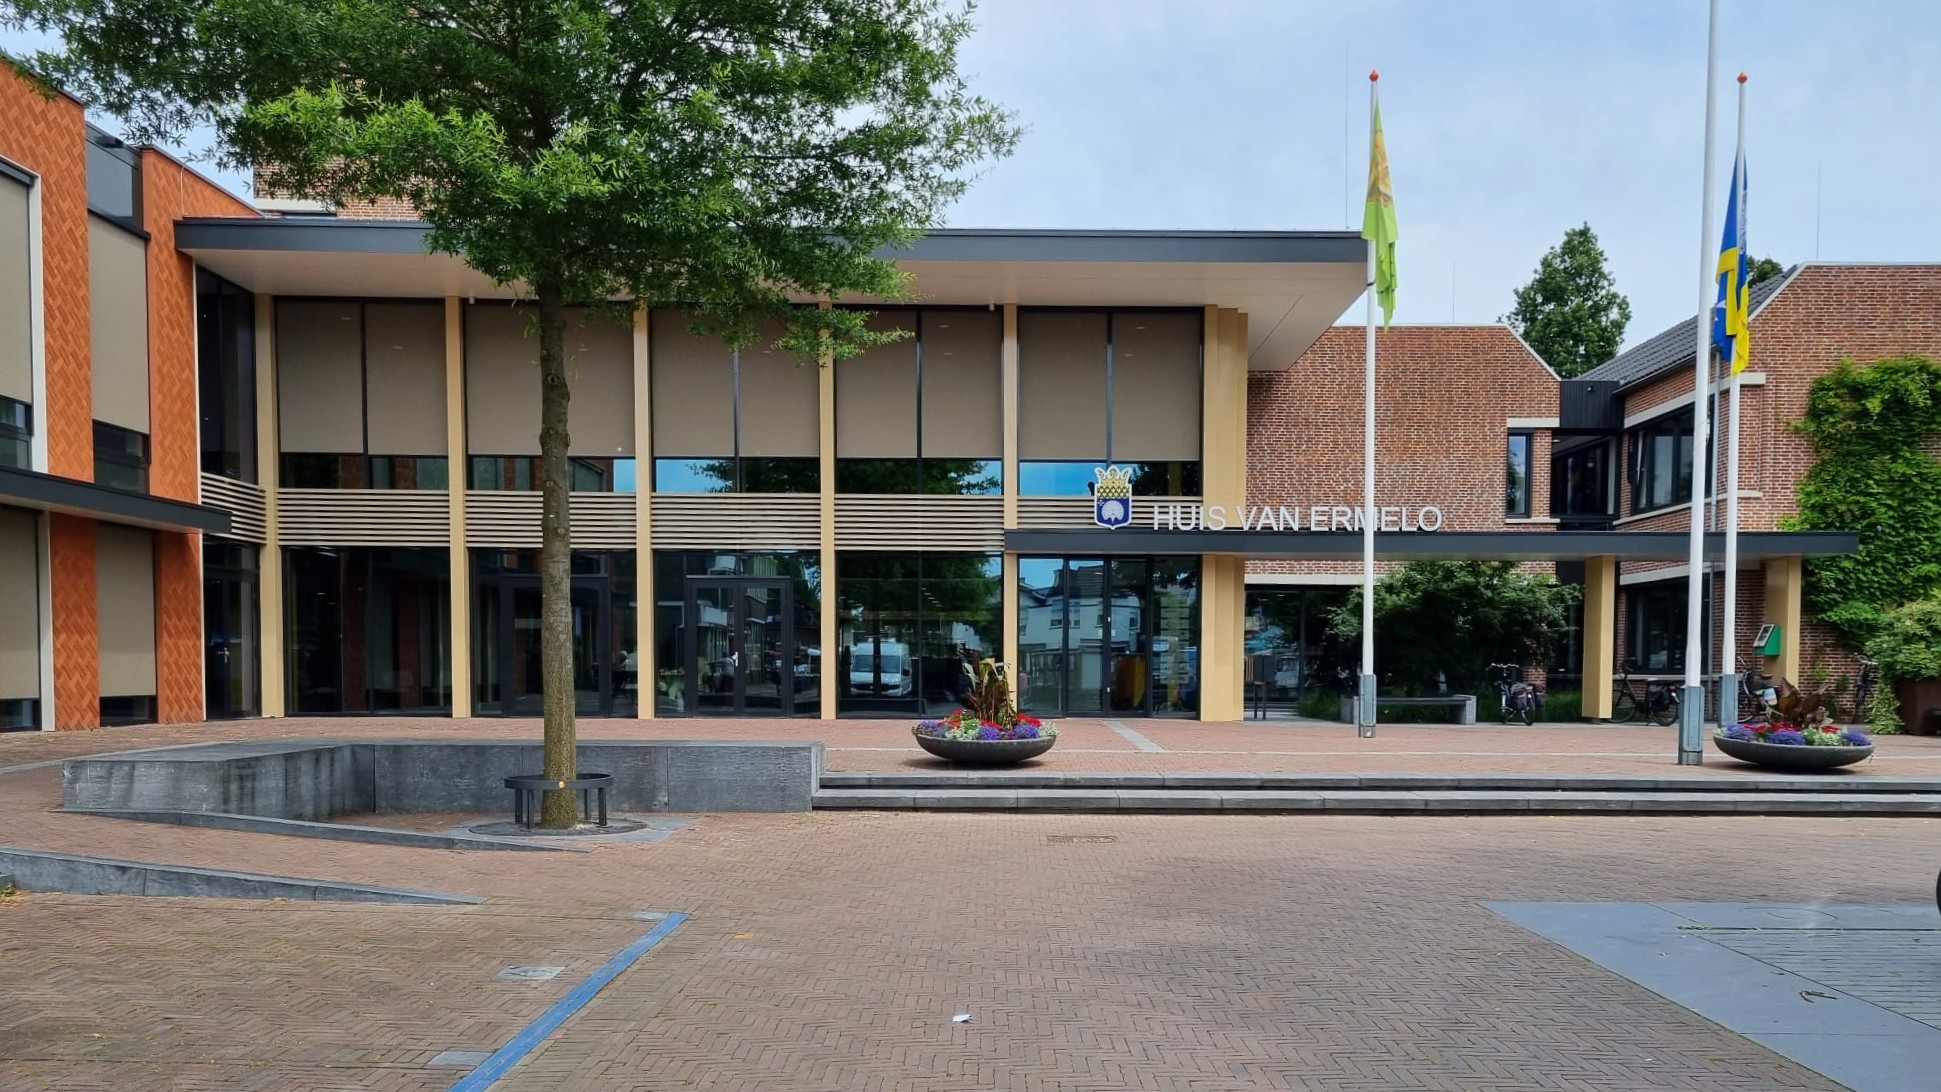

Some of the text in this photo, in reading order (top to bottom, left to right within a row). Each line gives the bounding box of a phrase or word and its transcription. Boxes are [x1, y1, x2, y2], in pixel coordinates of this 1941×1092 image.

[1153, 505, 1443, 531] HUIS VAN ERMELO
